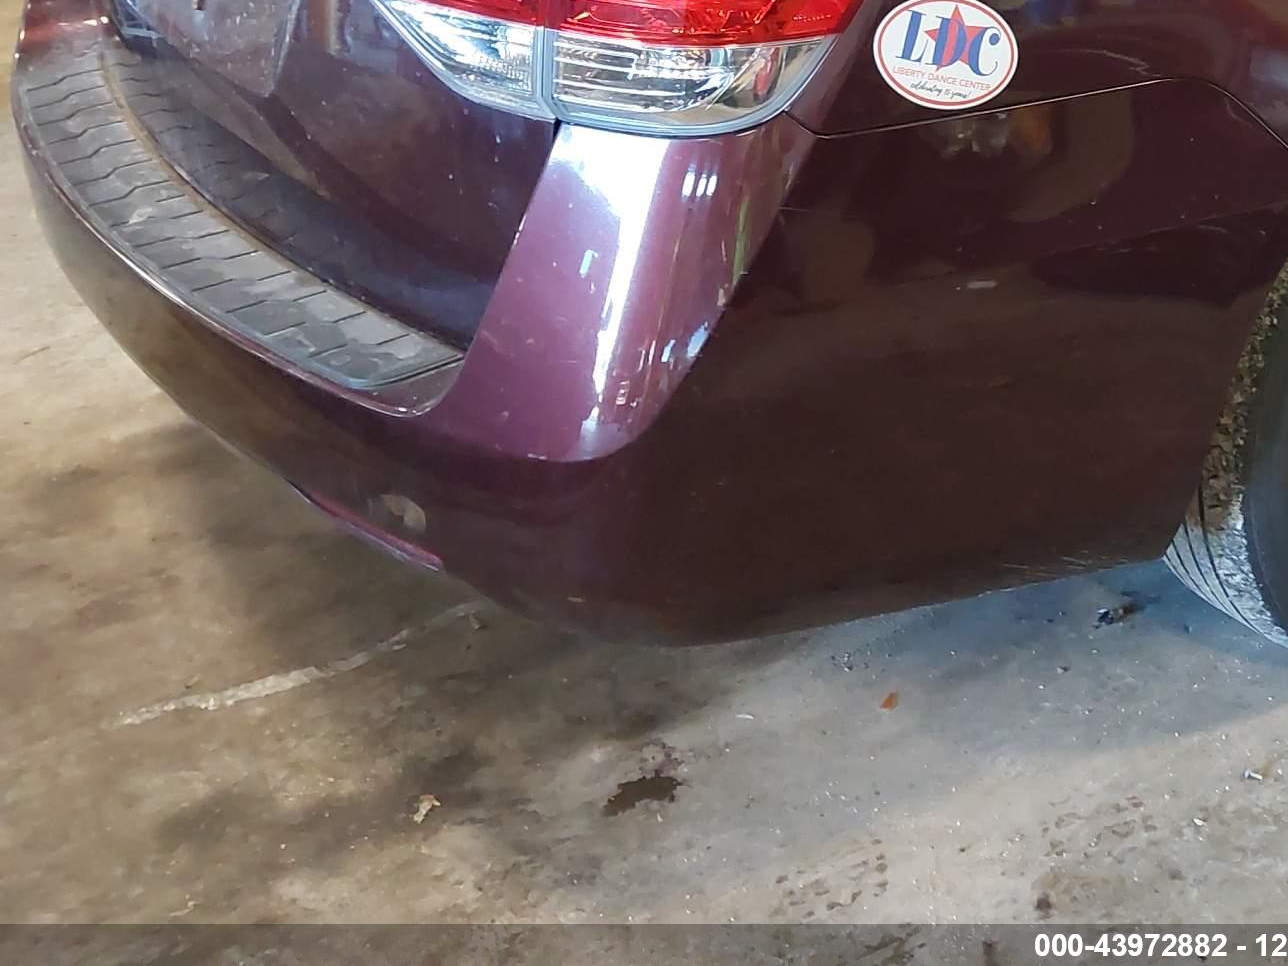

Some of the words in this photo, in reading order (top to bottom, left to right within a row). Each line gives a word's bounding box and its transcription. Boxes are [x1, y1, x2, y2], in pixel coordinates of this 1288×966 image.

[895, 9, 1002, 77] LDC
[892, 65, 925, 79] LIBERTY
[927, 72, 958, 86] DANCE
[959, 78, 991, 91] CENTER
